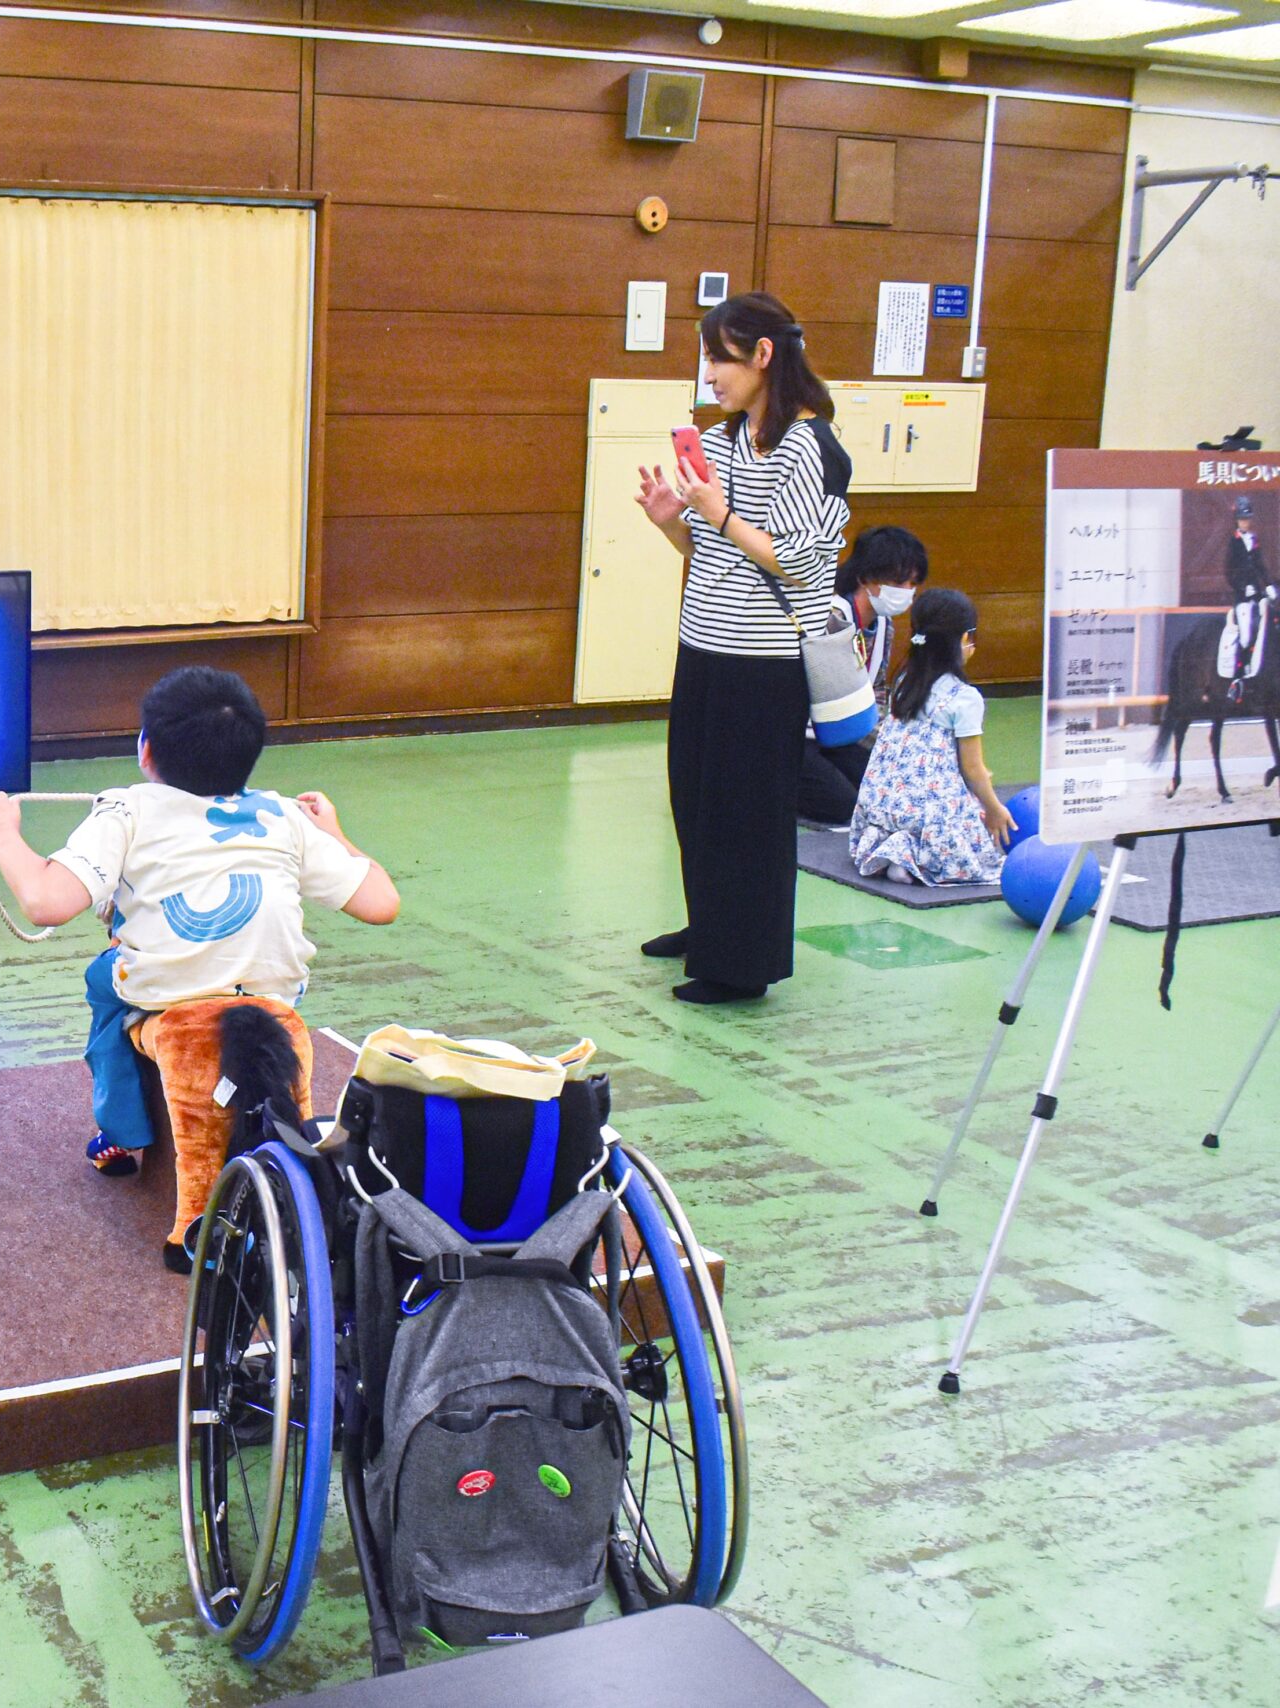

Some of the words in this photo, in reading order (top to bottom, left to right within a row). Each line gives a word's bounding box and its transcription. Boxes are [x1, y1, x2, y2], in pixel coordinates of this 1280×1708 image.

[1069, 523, 1120, 539] ヘルメット
[1069, 568, 1136, 582] ユニフォーム
